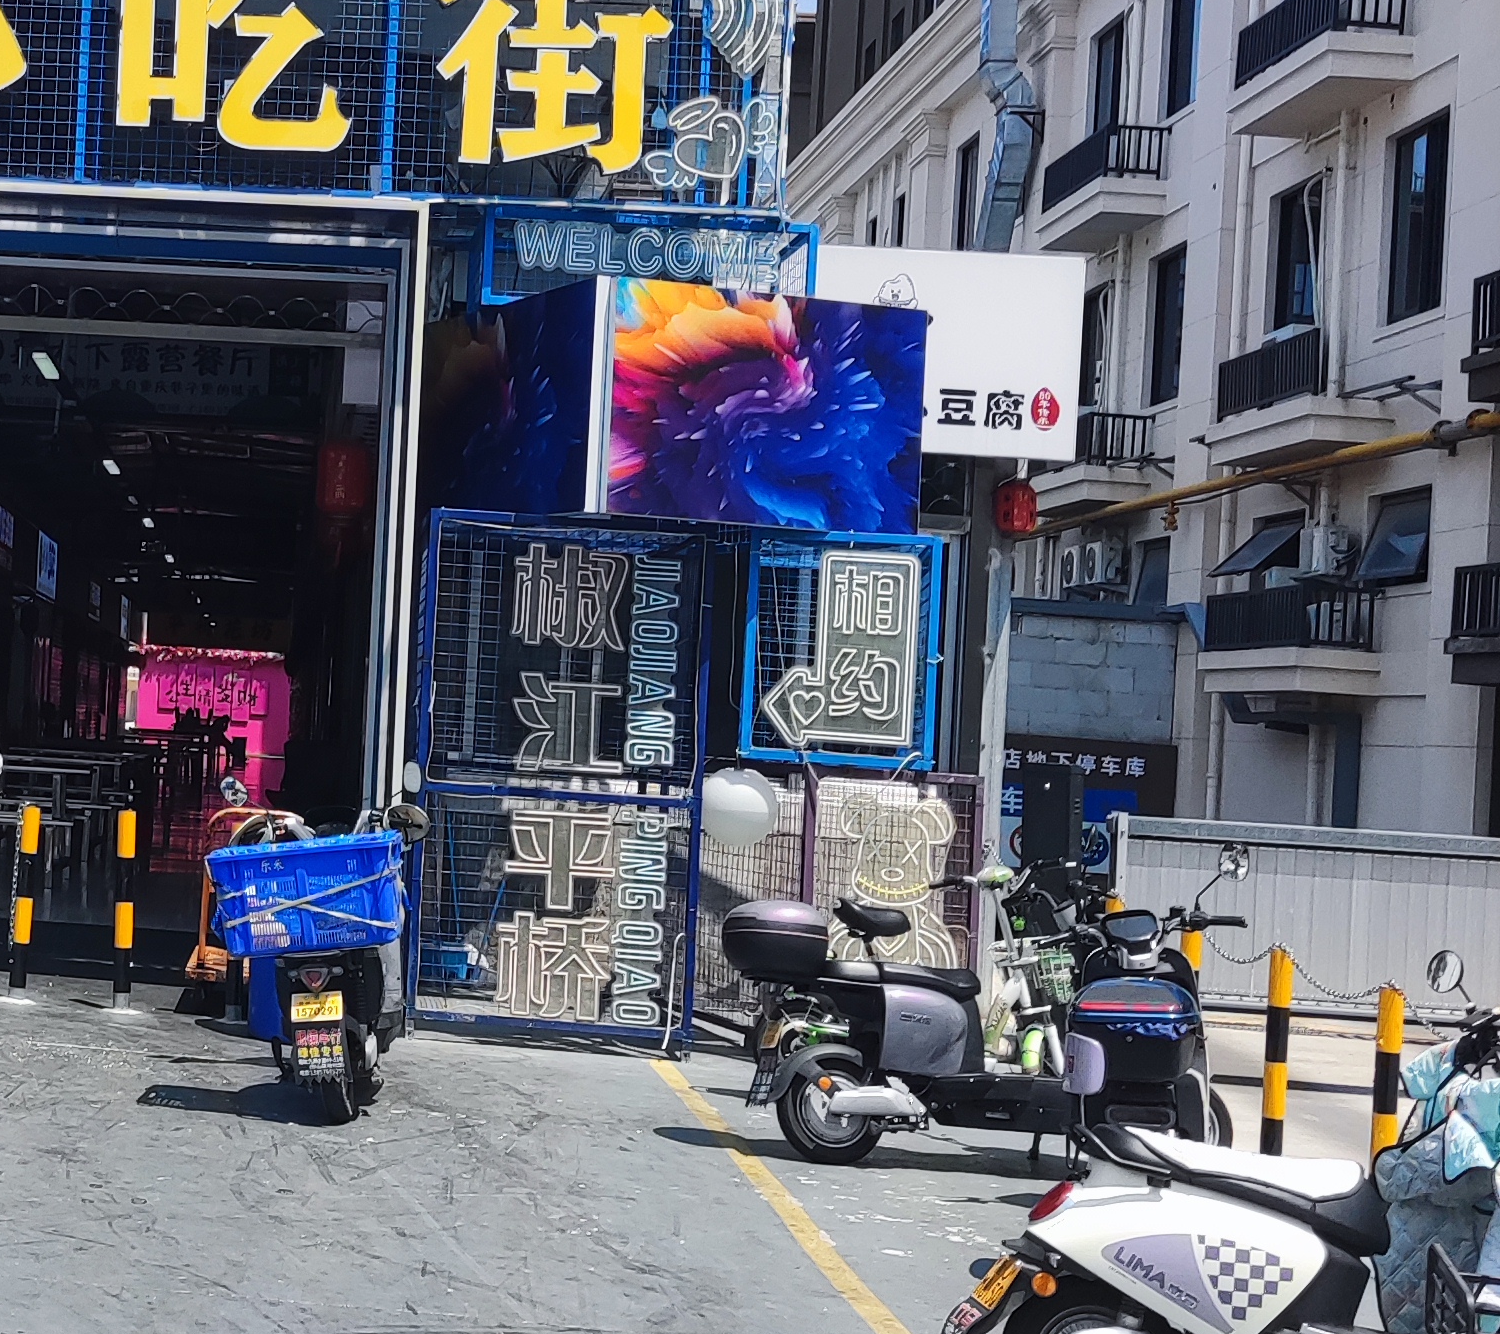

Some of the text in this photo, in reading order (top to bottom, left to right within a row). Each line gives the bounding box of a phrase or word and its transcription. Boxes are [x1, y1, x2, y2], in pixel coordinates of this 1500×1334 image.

[517, 222, 780, 284] WELCOME
[937, 388, 1024, 430] 豆腐
[511, 543, 629, 773] 椒江
[627, 553, 683, 767] JIAOJIANG
[829, 565, 906, 722] 相约
[495, 809, 615, 1022] 平桥
[1113, 1246, 1165, 1289] LIMA
